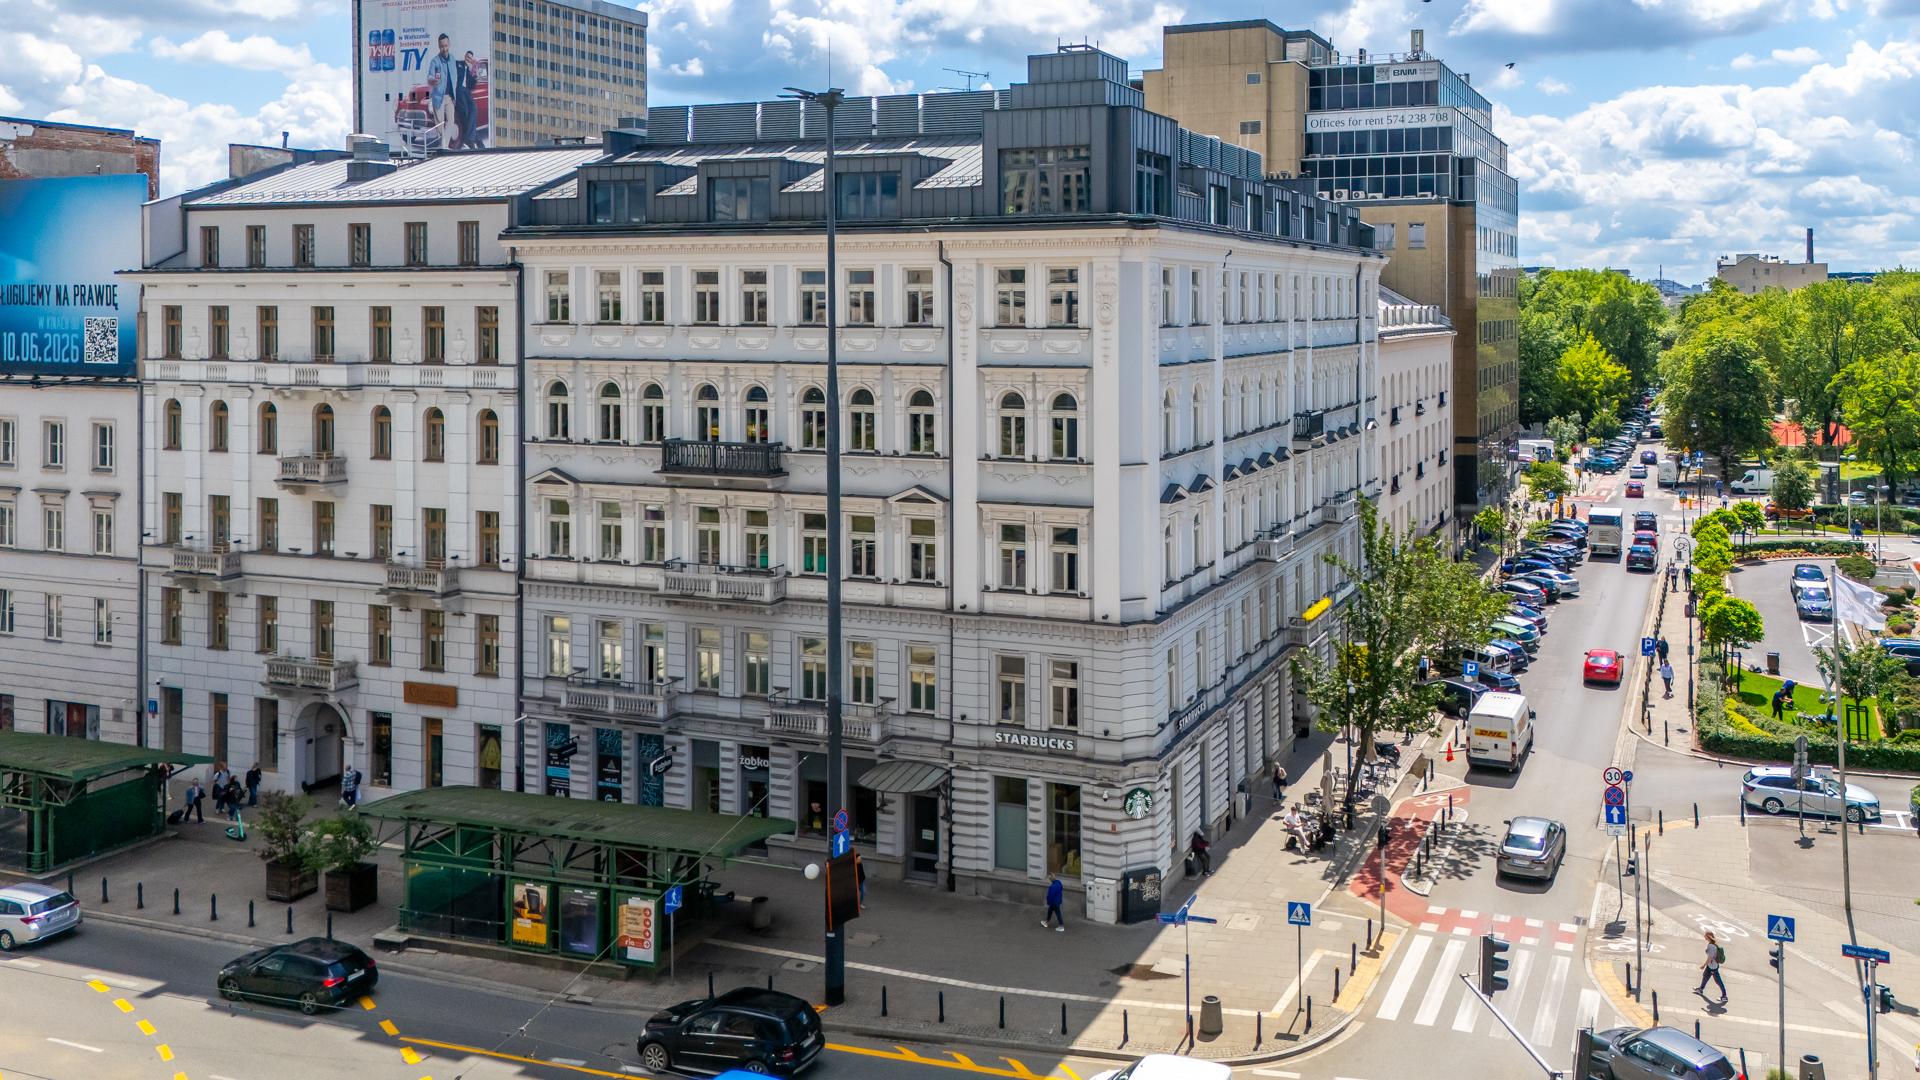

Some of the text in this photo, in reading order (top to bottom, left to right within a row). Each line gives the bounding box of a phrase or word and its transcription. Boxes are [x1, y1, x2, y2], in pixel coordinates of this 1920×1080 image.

[400, 47, 428, 71] TY
[1393, 68, 1417, 77] BNM
[1310, 112, 1449, 129] Offices for rent 574 238 708
[56, 284, 69, 306] NA
[73, 284, 118, 310] PRAWDĘ
[3, 332, 79, 363] 10.06.2026
[1644, 639, 1653, 649] P
[1467, 664, 1476, 674] P
[1479, 729, 1503, 737] DHL
[995, 732, 1074, 751] STARBUCKS
[739, 755, 769, 768] żabka
[1606, 771, 1620, 782] 30
